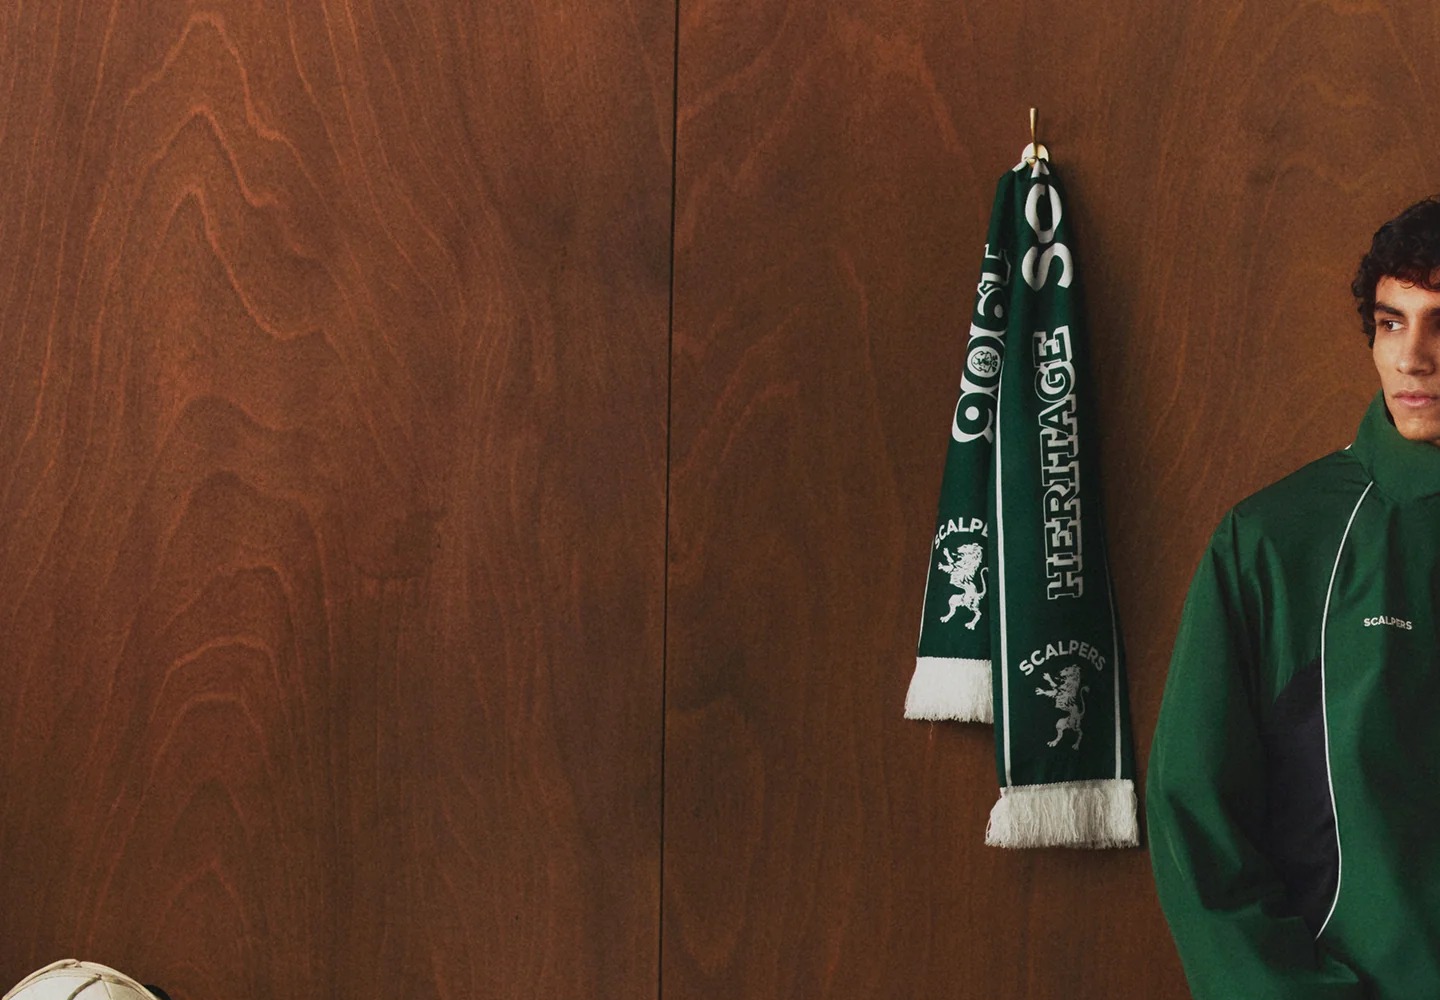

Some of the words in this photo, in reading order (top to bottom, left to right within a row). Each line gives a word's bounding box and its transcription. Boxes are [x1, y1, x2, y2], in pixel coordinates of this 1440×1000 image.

[1032, 325, 1084, 600] HERITAGE
[1363, 614, 1413, 631] SCALPERS
[1018, 639, 1106, 677] SCALPERS
